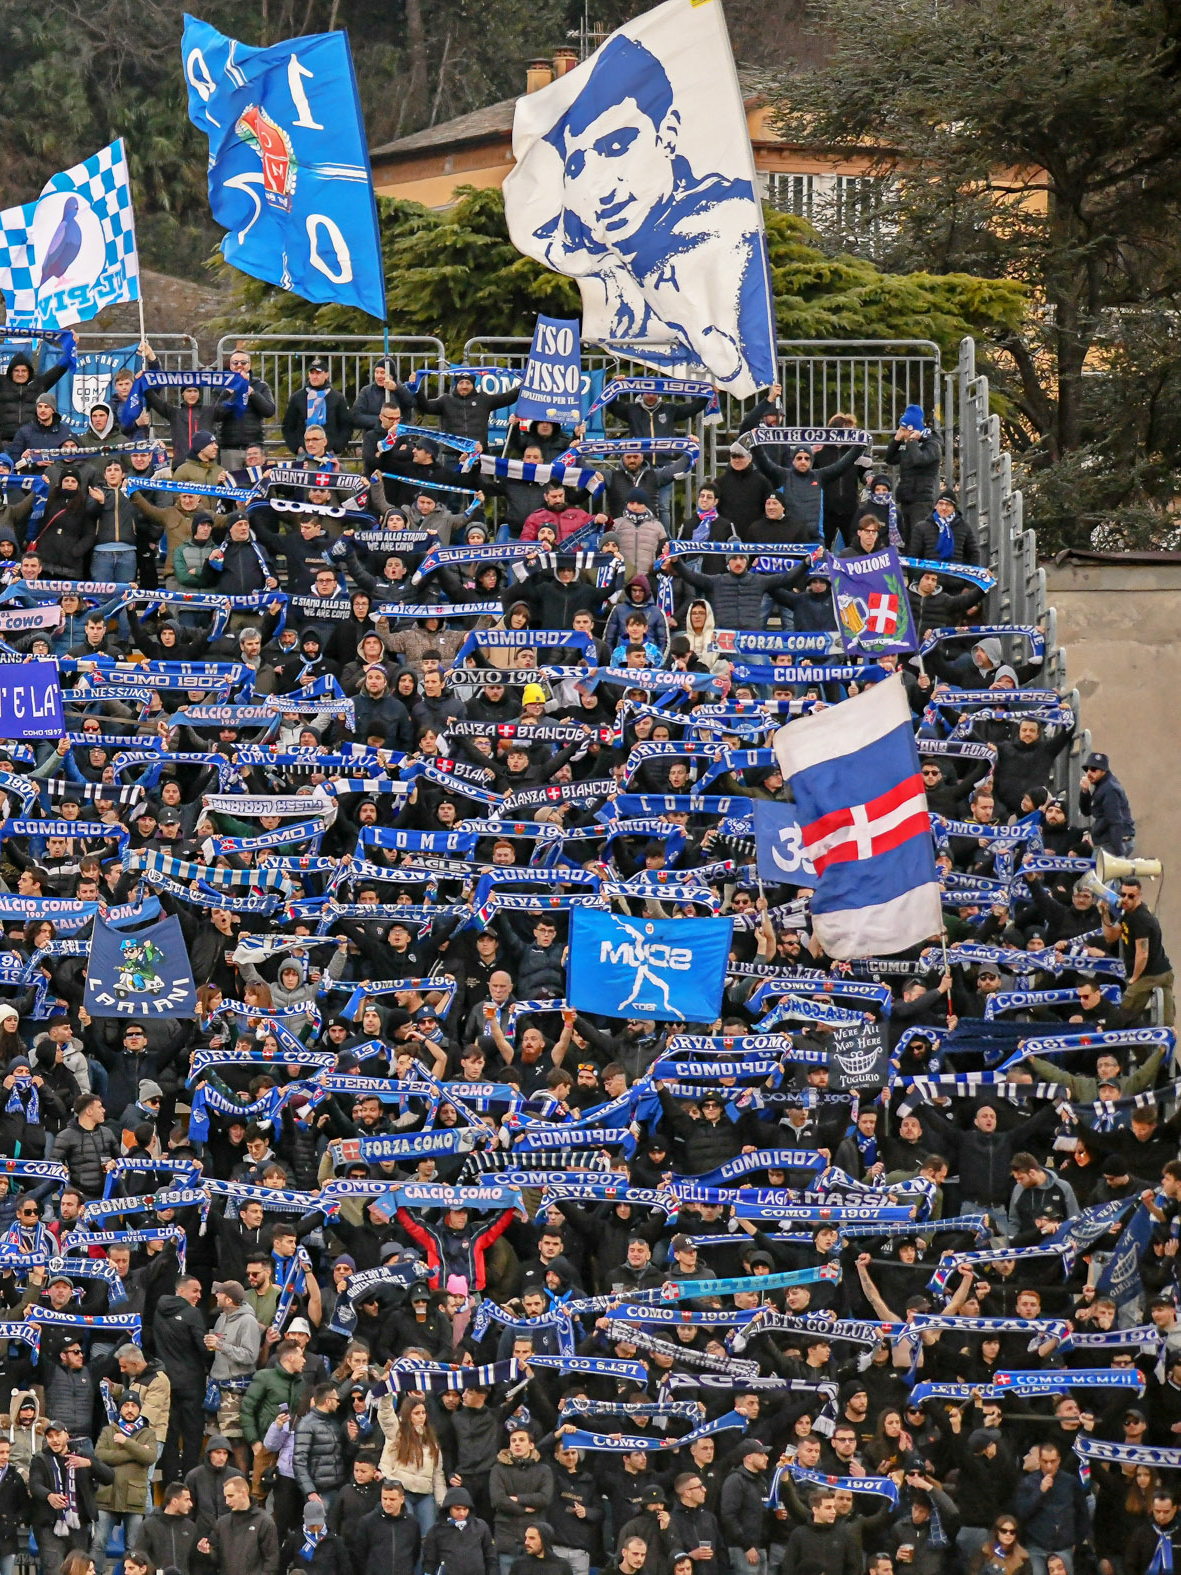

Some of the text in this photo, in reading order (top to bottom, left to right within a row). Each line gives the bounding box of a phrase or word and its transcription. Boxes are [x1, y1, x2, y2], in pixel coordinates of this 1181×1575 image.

[536, 323, 574, 357] TSO
[523, 359, 580, 393] FISSO
[601, 378, 654, 399] COMO
[553, 396, 565, 404] PER
[757, 429, 826, 444] GO BLUES
[578, 440, 699, 454] COMO 1907
[270, 471, 309, 485] AVANTI
[361, 532, 428, 542] SIAMO ALLO STADIO
[367, 542, 413, 552] WE ARE COMO
[673, 541, 716, 552] AMICI
[846, 553, 891, 576] POZIONE
[26, 580, 117, 593] CALCIO COMO
[739, 635, 826, 650] FORZA COMO
[109, 674, 169, 686] COMO
[655, 674, 695, 685] COMO
[87, 687, 151, 698] NESSUNO
[935, 690, 1058, 704] SUPPORTERS
[15, 684, 25, 717] E
[31, 683, 59, 717] LA'
[185, 706, 276, 718] CALCIO COMO
[241, 830, 297, 848] COMO
[41, 900, 83, 912] COMO
[88, 977, 190, 1015] LARIANI
[770, 982, 879, 996] COMO 1907
[856, 1035, 881, 1048] HERE
[326, 1078, 394, 1091] ETERNA
[839, 1072, 880, 1088] TUGURIO
[451, 1084, 494, 1096] COMO
[365, 1132, 455, 1156] FORZA COMO
[494, 1173, 623, 1185] COMO 1907
[325, 1182, 386, 1194] COMO
[405, 1186, 503, 1200] CALCIO COMO
[666, 1186, 709, 1201] QUELLI
[89, 1196, 137, 1216] COMO
[760, 1208, 880, 1220] COMO 1907
[68, 1230, 115, 1244] CALCIO
[33, 1307, 136, 1325] COMO 1907
[626, 1306, 739, 1322] COMO 1907
[763, 1313, 879, 1342] LET'S GO BLUES
[1017, 1374, 1131, 1386] COMO MCMVII
[846, 1479, 883, 1490] 1907
